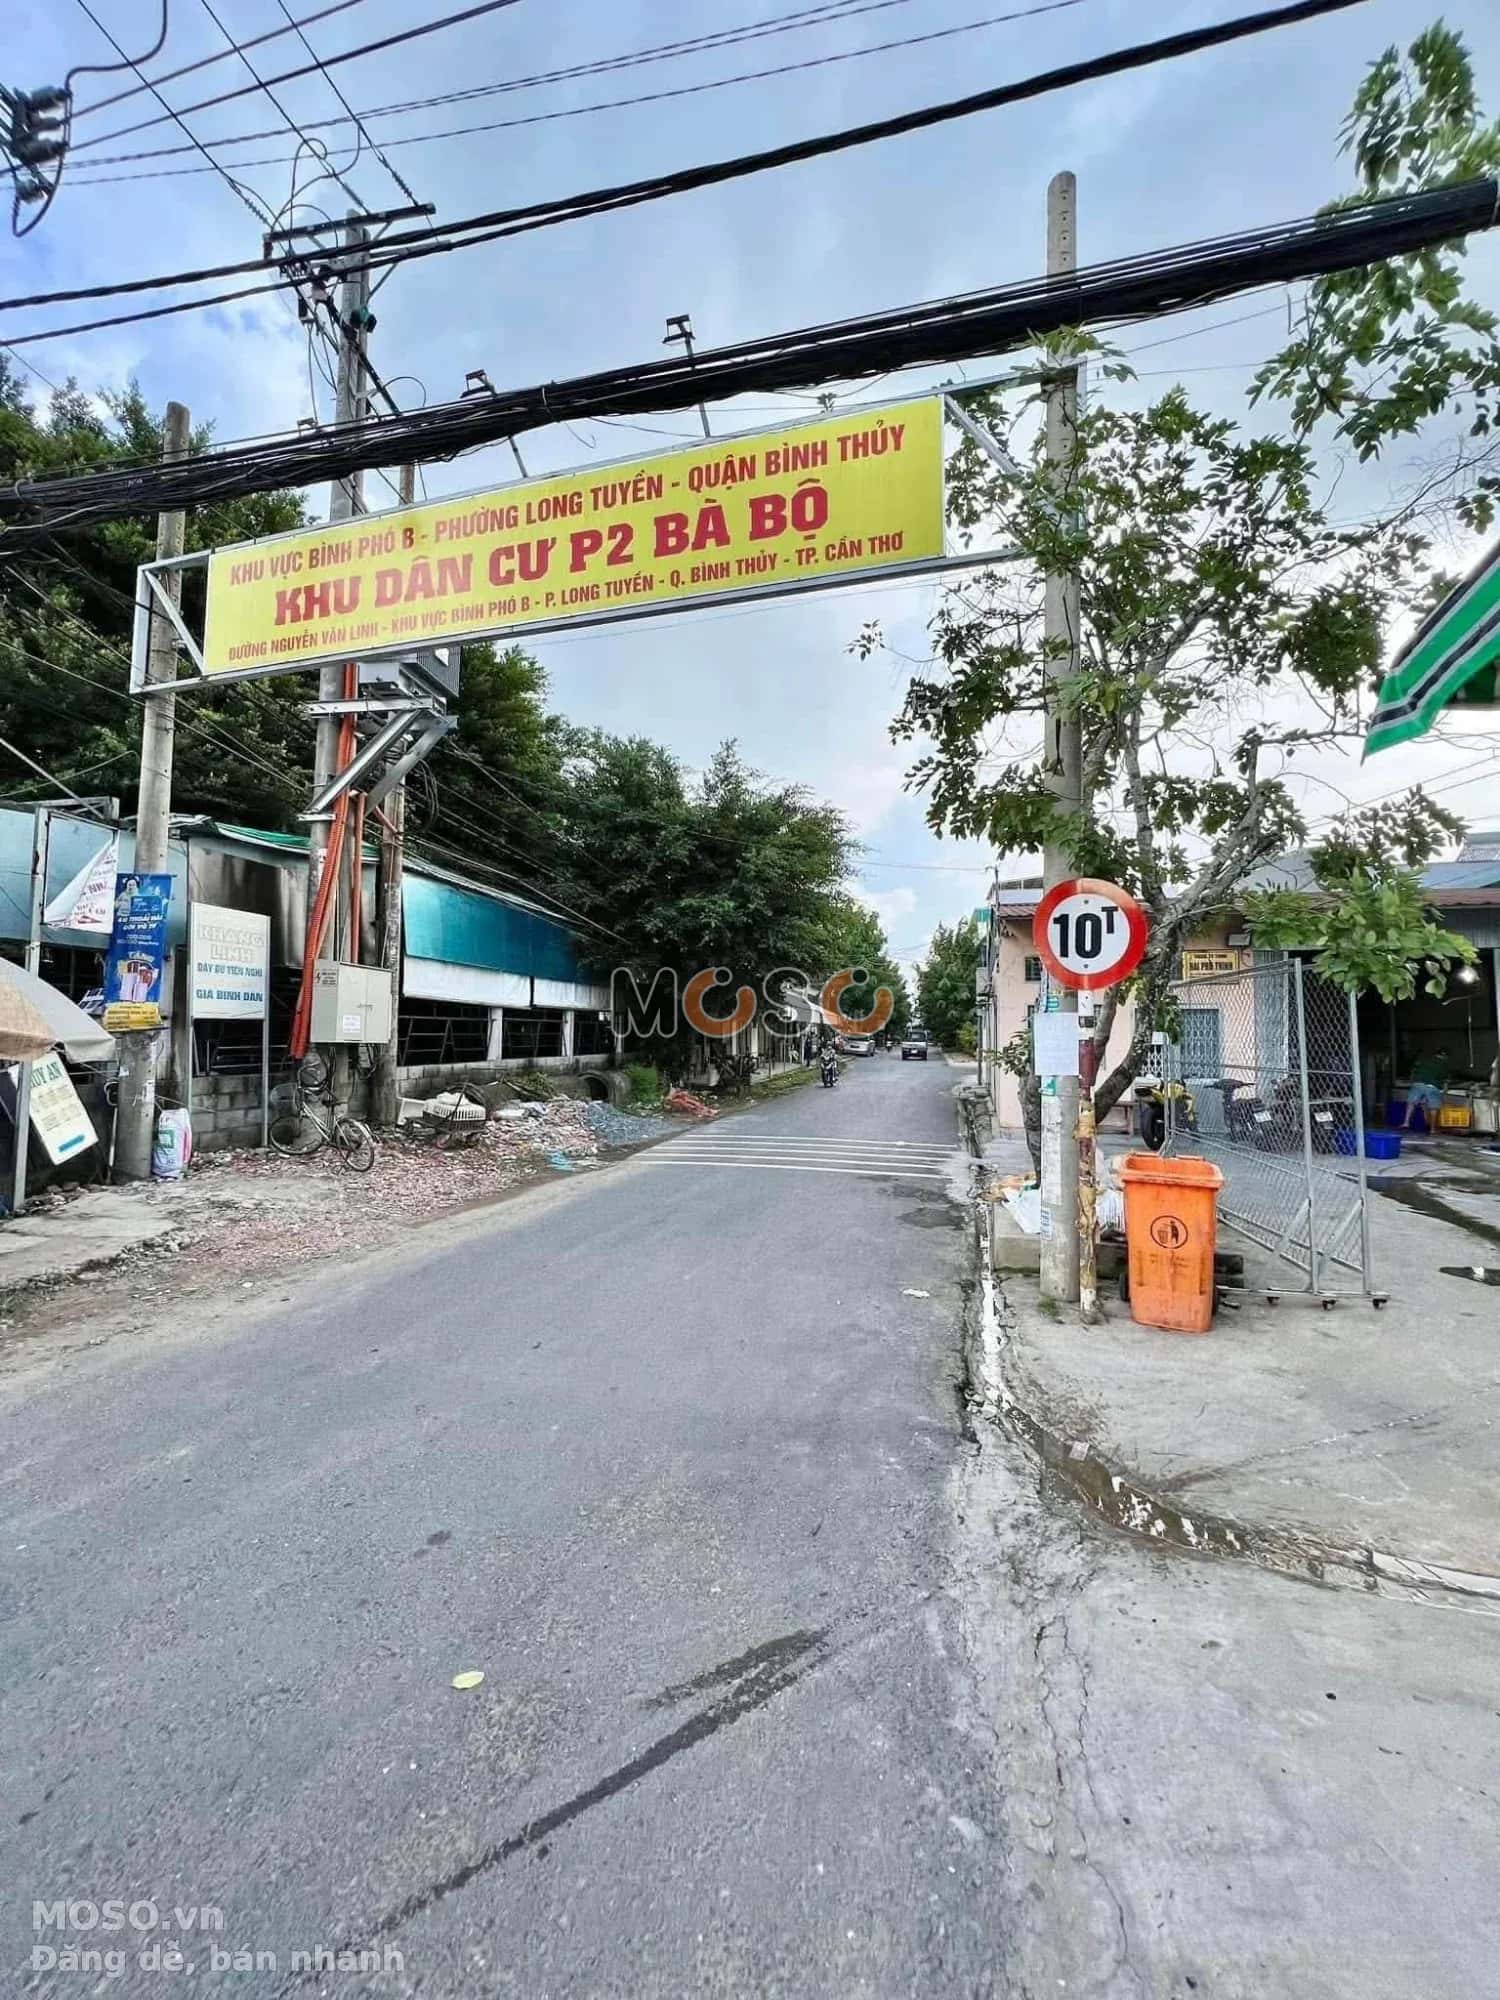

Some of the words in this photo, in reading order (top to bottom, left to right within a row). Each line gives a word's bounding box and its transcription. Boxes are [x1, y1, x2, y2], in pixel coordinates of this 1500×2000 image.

[230, 559, 264, 586] KHU
[270, 551, 302, 580] VỰC
[309, 541, 352, 568] BÌNH
[402, 527, 414, 549] B
[435, 506, 519, 543] PHƯỜNG
[525, 491, 583, 525] LONG
[688, 454, 756, 493] QUẬN
[765, 442, 828, 476] BÌNH
[837, 419, 905, 462] THỦY
[274, 576, 361, 626] KHU
[374, 555, 473, 609] DÂN
[489, 537, 557, 586] CƯ
[569, 523, 634, 573] P2
[654, 498, 730, 558] BÀ
[749, 478, 828, 541] BỘ
[350, 621, 378, 641] LINH
[392, 615, 418, 634] KHU
[451, 602, 485, 625] BÌNH
[521, 597, 530, 612] B
[545, 593, 556, 608] P.
[561, 584, 600, 605] LONG
[670, 570, 685, 588] Q.
[691, 559, 730, 583] BÌNH
[736, 549, 777, 576] THỦY
[795, 547, 819, 566] TP.
[868, 530, 904, 555] THƠ
